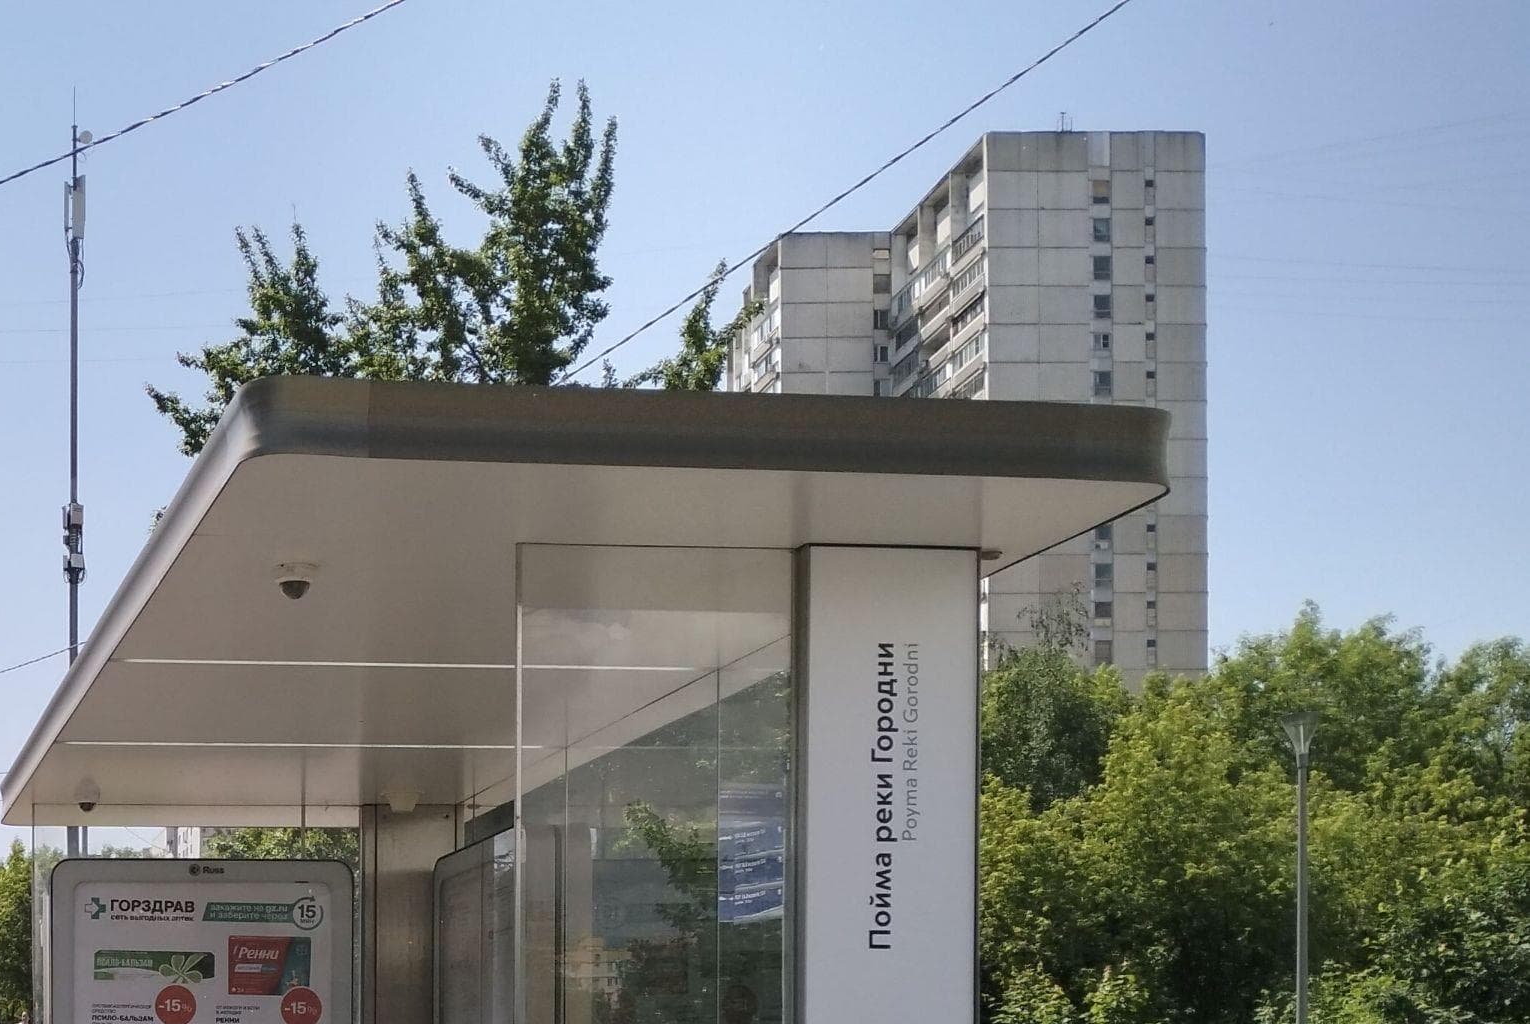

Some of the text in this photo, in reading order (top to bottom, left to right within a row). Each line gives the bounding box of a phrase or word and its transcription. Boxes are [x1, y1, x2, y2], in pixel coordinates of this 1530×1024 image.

[902, 642, 921, 842] Poyma Reki Gorodni
[869, 642, 898, 950] Пойма реки Городни
[110, 899, 195, 914] ГОРЗДРАВ
[297, 905, 316, 919] 15
[238, 946, 279, 960] Ренни
[91, 1014, 154, 1022] ПСИЛО-БАЛЬЗАМ
